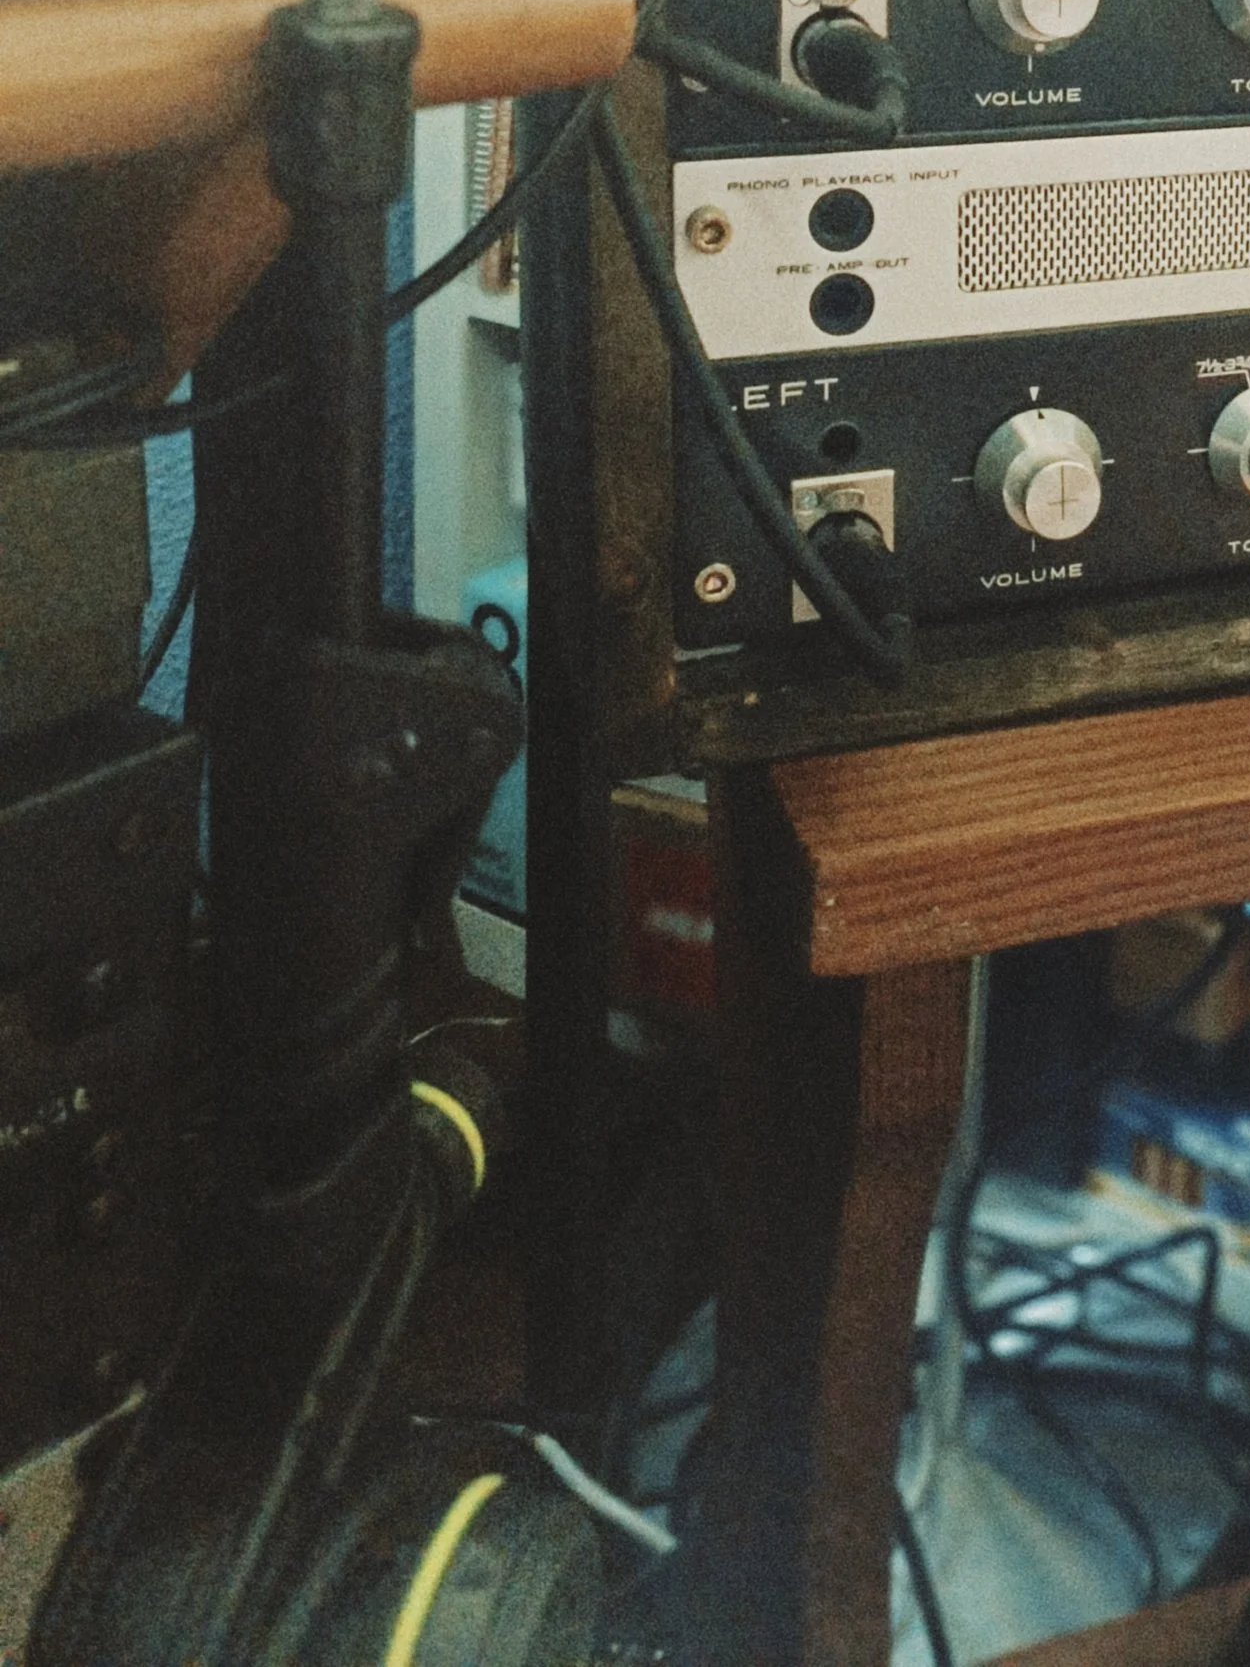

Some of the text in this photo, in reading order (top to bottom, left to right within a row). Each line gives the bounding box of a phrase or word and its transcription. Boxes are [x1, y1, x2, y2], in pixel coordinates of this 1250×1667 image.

[974, 87, 1082, 107] VOLUME
[727, 169, 960, 191] PHONO PLAYBACK INPUT
[775, 257, 910, 276] PRE AMP OUT
[731, 377, 839, 411] EFT
[980, 562, 1083, 589] VOLUME
